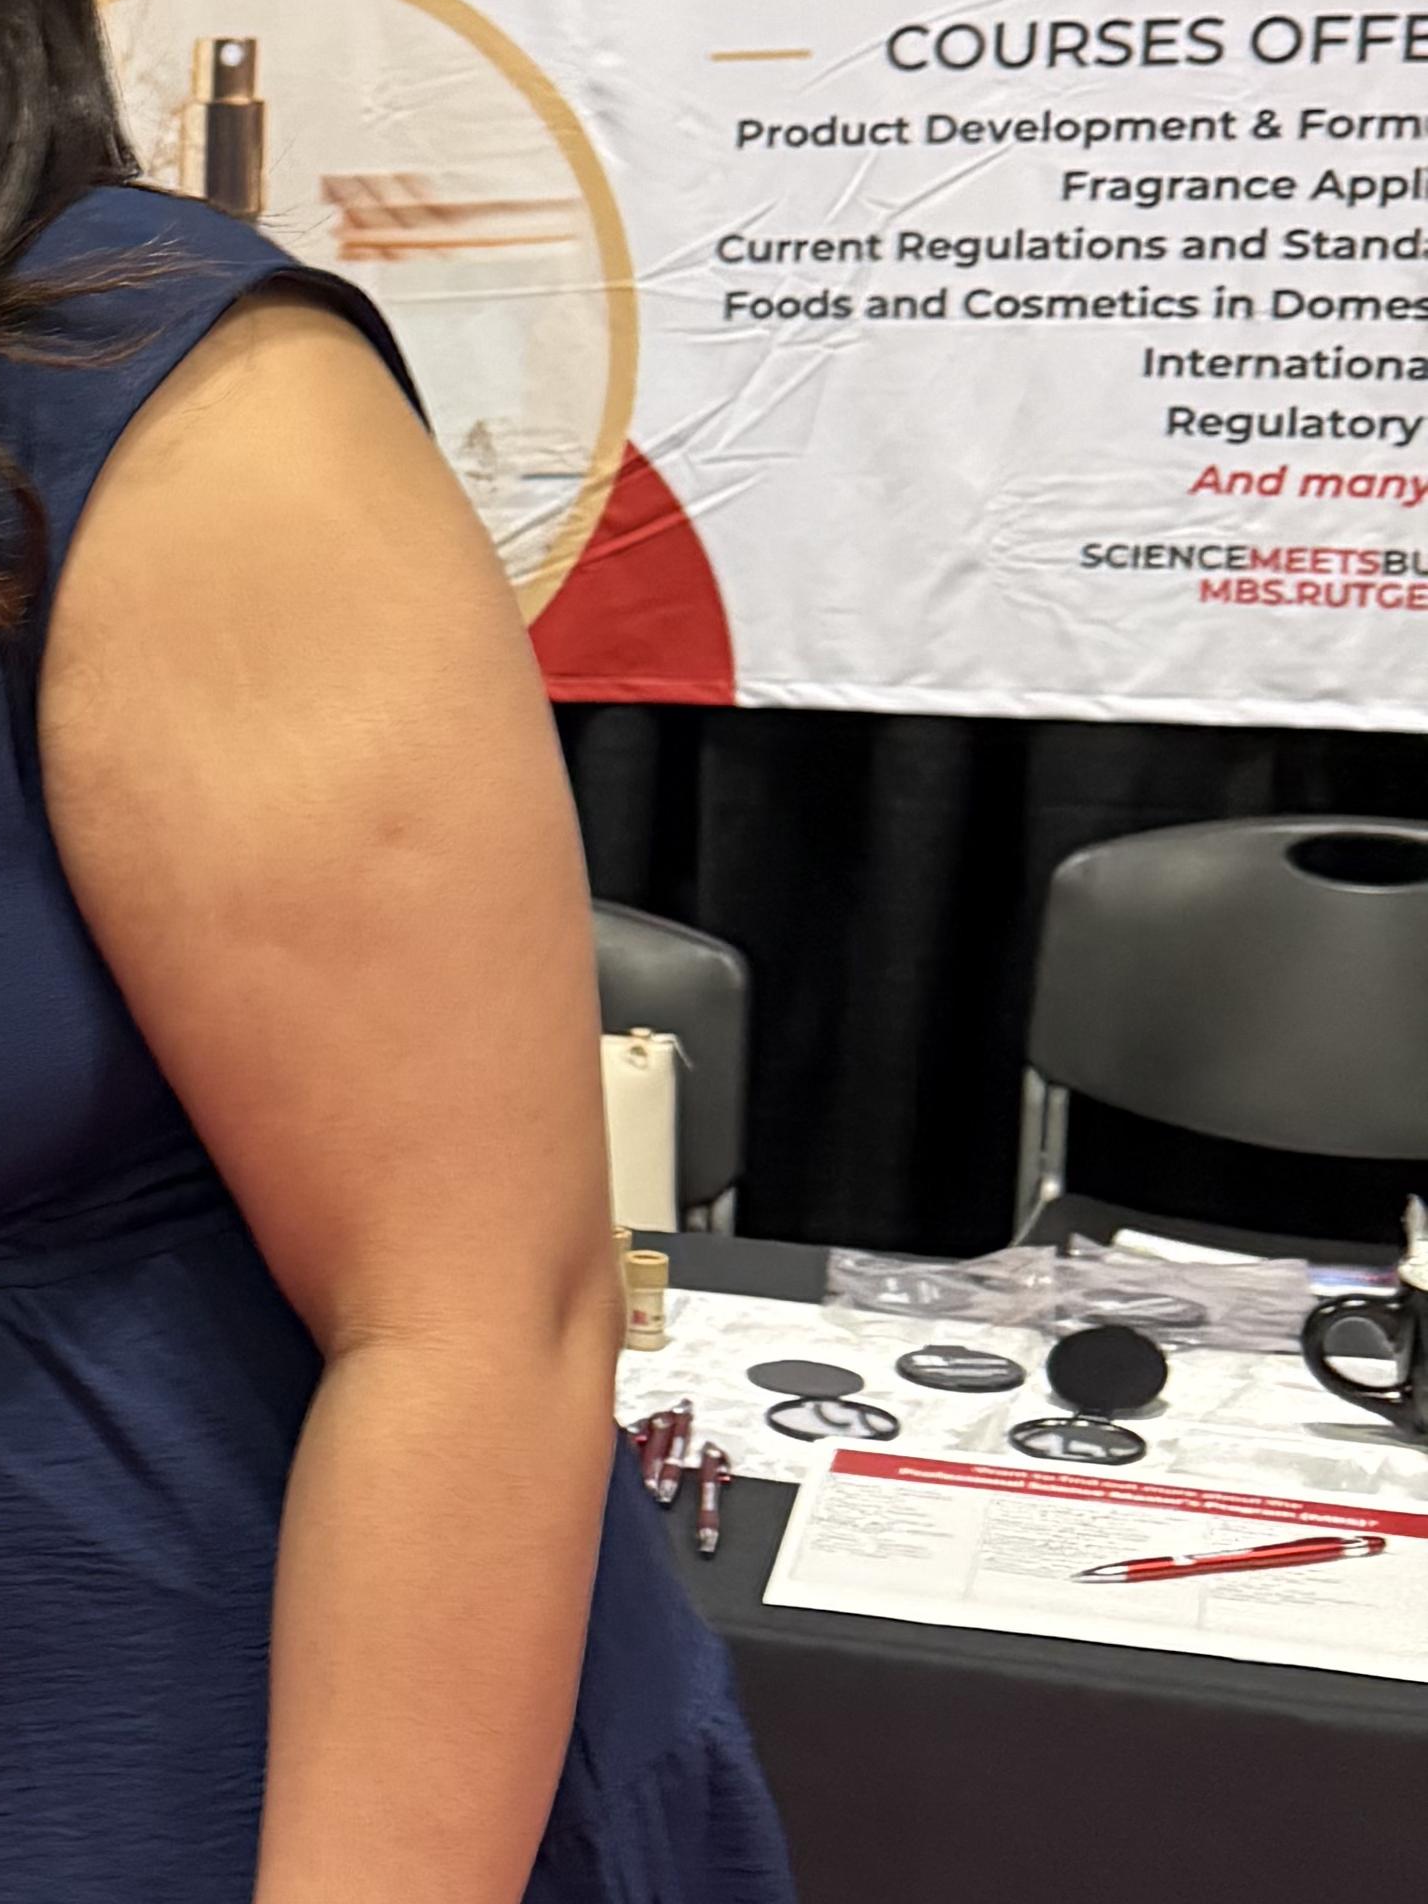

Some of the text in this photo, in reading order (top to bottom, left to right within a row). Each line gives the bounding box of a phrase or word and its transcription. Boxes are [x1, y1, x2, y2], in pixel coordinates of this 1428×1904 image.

[885, 16, 1224, 72] COURSES
[735, 108, 1428, 150] Product Development & Form
[1061, 169, 1297, 209] Fragrance
[716, 227, 1428, 268] Current Regulations and Stand
[723, 290, 853, 322] Foods
[867, 287, 947, 320] and
[963, 286, 1199, 320] Cosmetics
[1214, 286, 1254, 318] in
[1143, 345, 1428, 382] Internationa
[1165, 406, 1425, 447] Regulatory
[1188, 464, 1428, 508] And many
